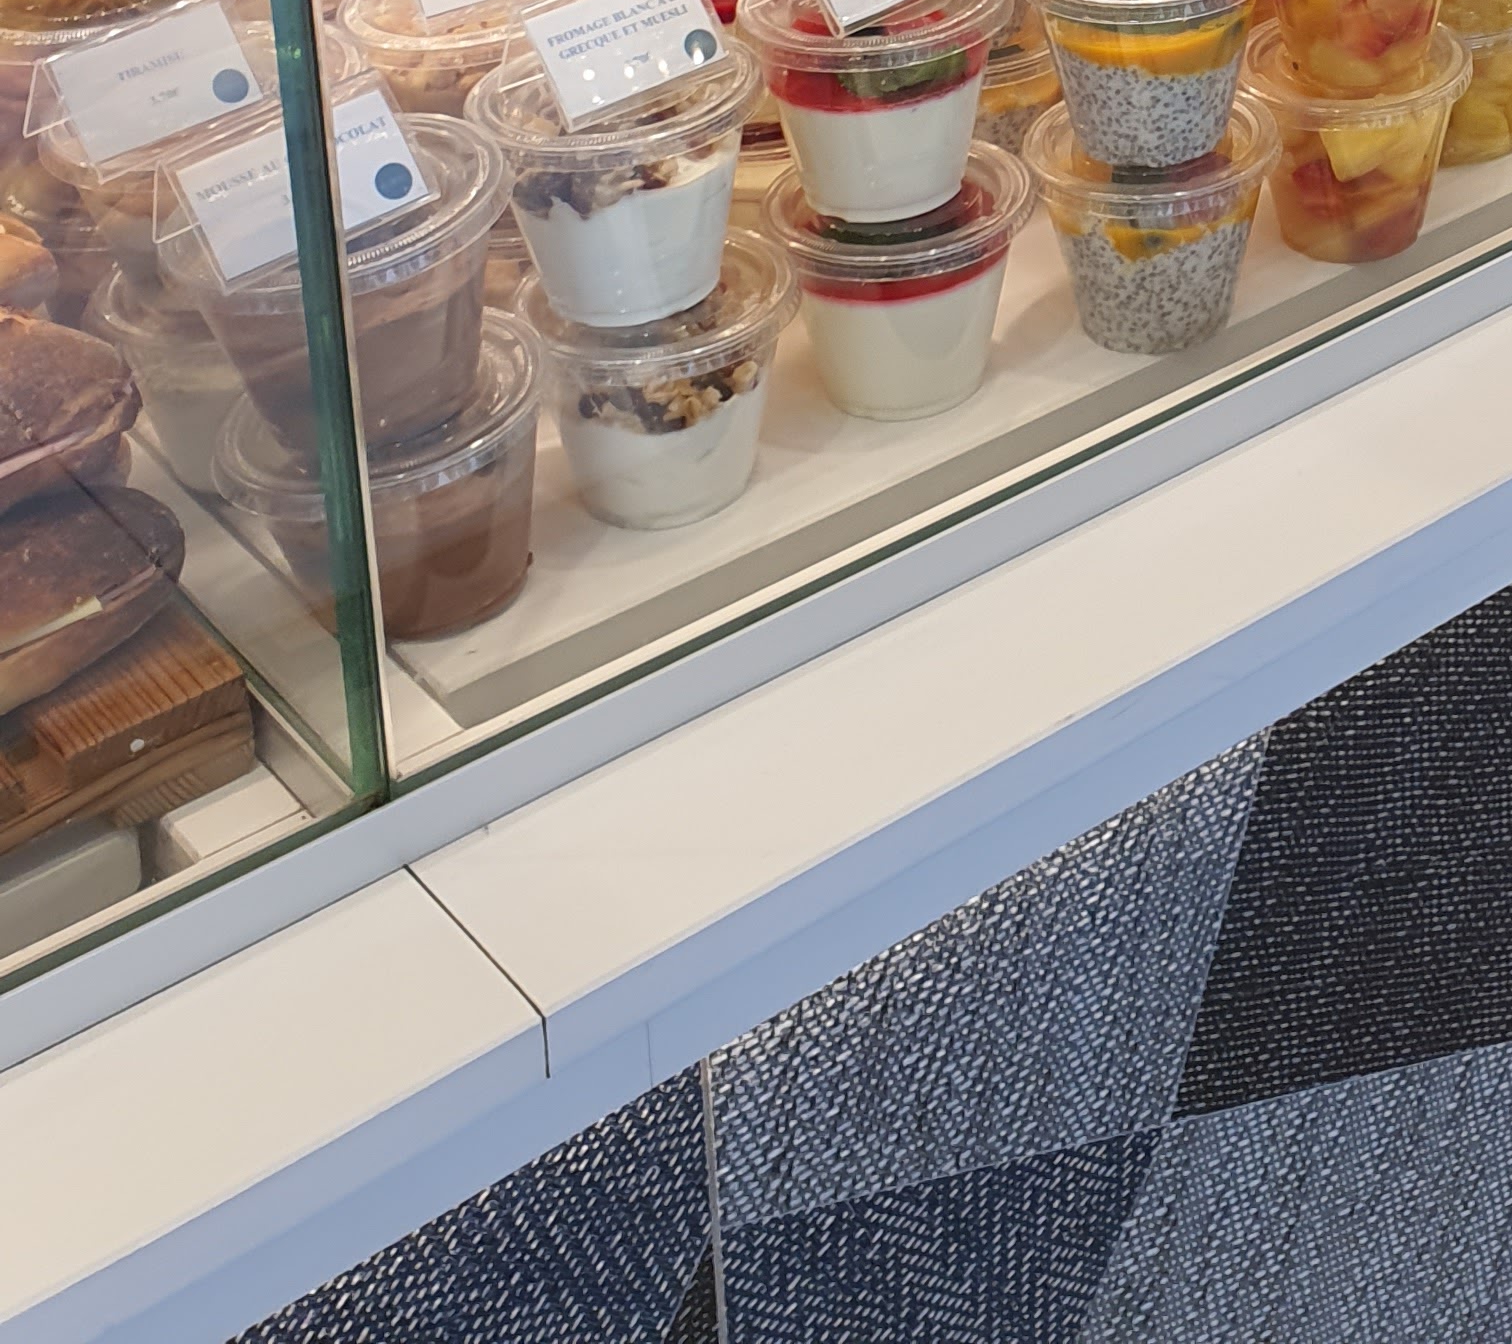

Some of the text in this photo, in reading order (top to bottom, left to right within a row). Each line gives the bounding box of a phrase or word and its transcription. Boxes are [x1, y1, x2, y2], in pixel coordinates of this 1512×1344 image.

[547, 15, 611, 48] FROMAGE
[558, 4, 689, 60] GRECQUE ET MUESLI
